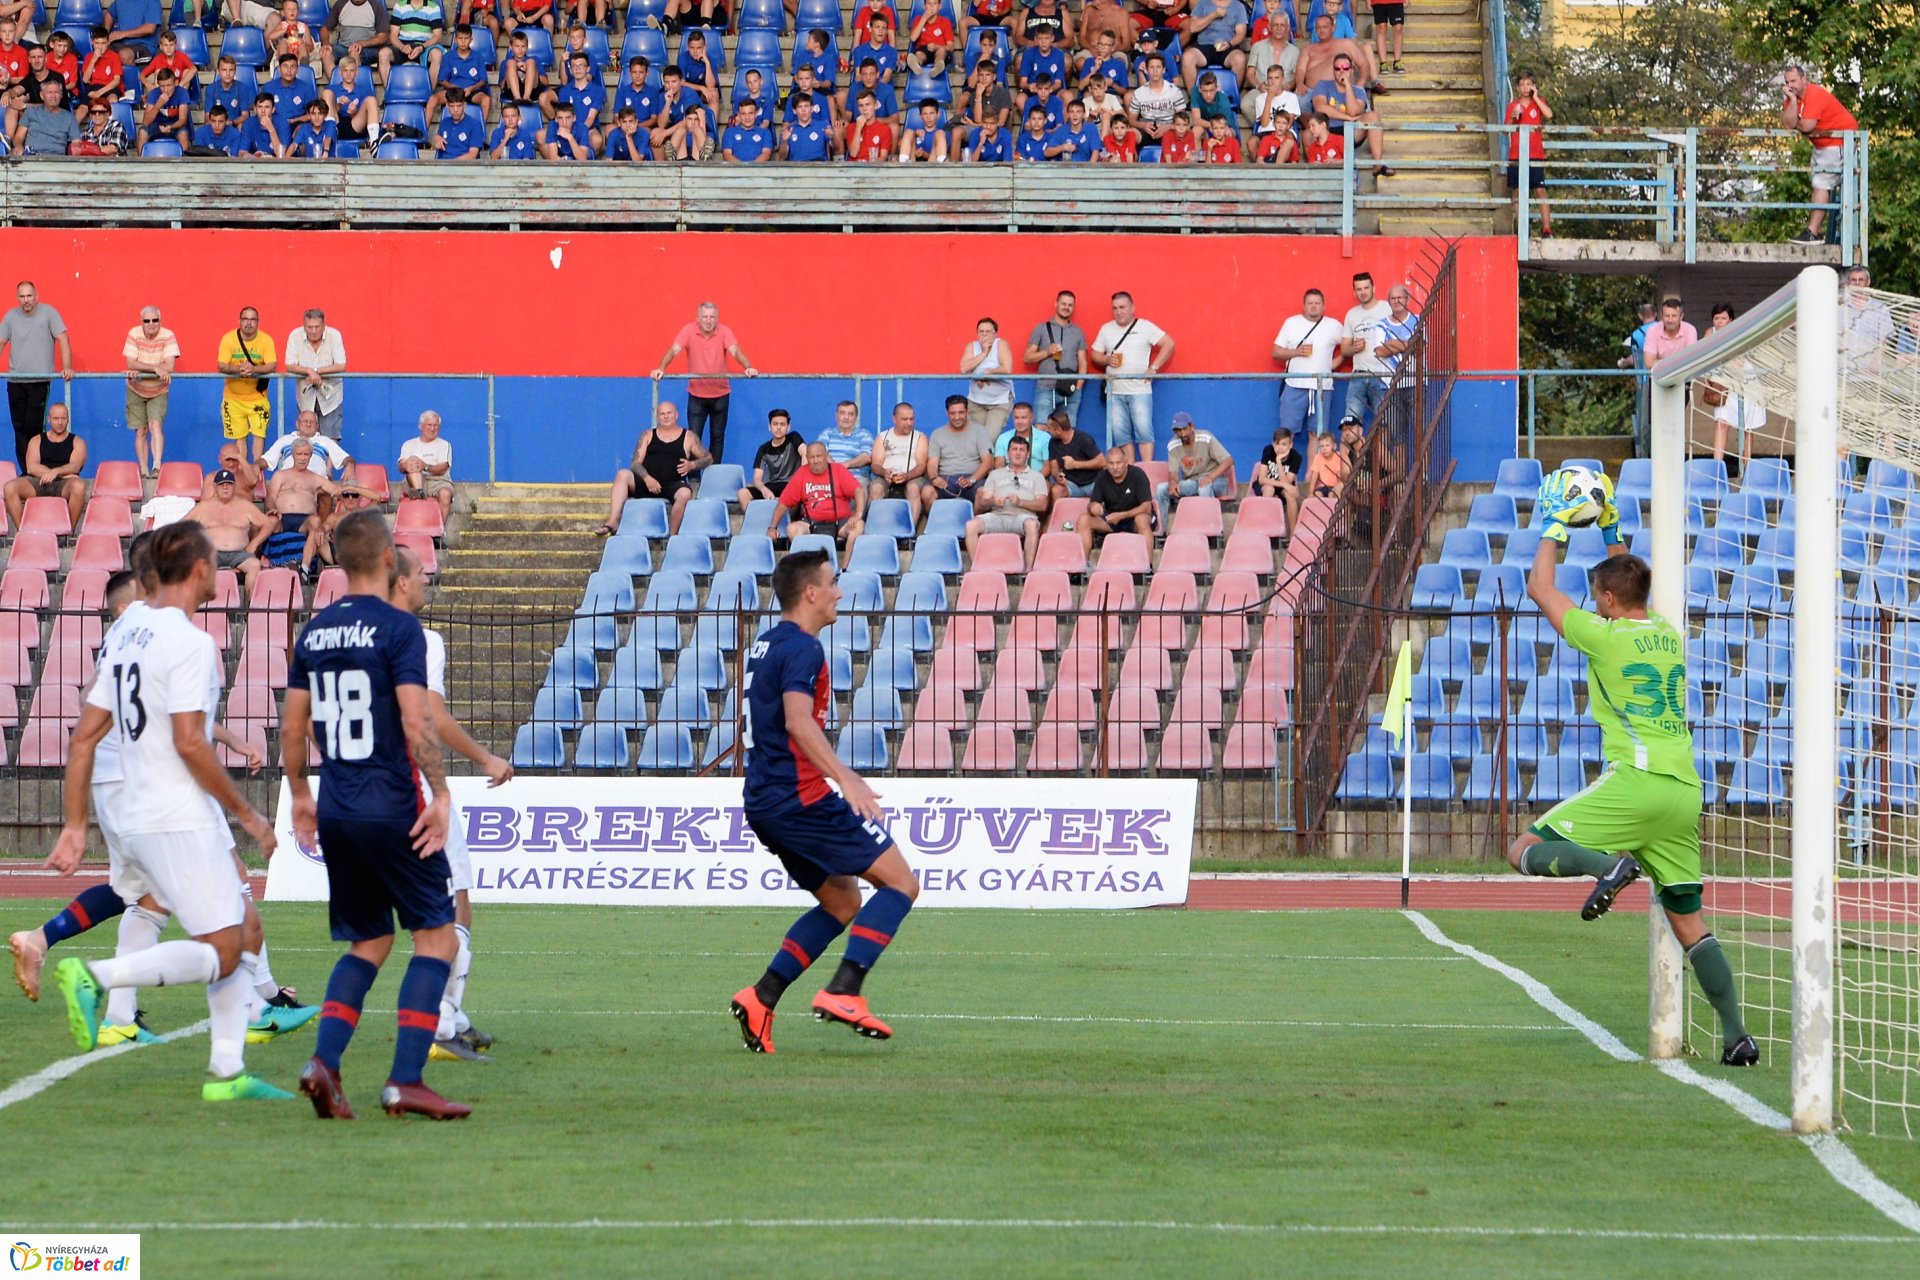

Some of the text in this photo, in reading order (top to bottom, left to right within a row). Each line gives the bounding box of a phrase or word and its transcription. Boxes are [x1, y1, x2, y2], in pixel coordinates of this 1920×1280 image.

[304, 619, 377, 650] HORNYÁK
[1633, 634, 1678, 654] DOROG
[113, 662, 147, 744] 13
[1621, 662, 1686, 720] 30
[307, 669, 375, 761] 48
[861, 819, 888, 845] 5
[476, 861, 695, 890] LKATRÉSZEK
[706, 861, 748, 891] ÉS
[979, 864, 1164, 893] GYÁRTÁSA
